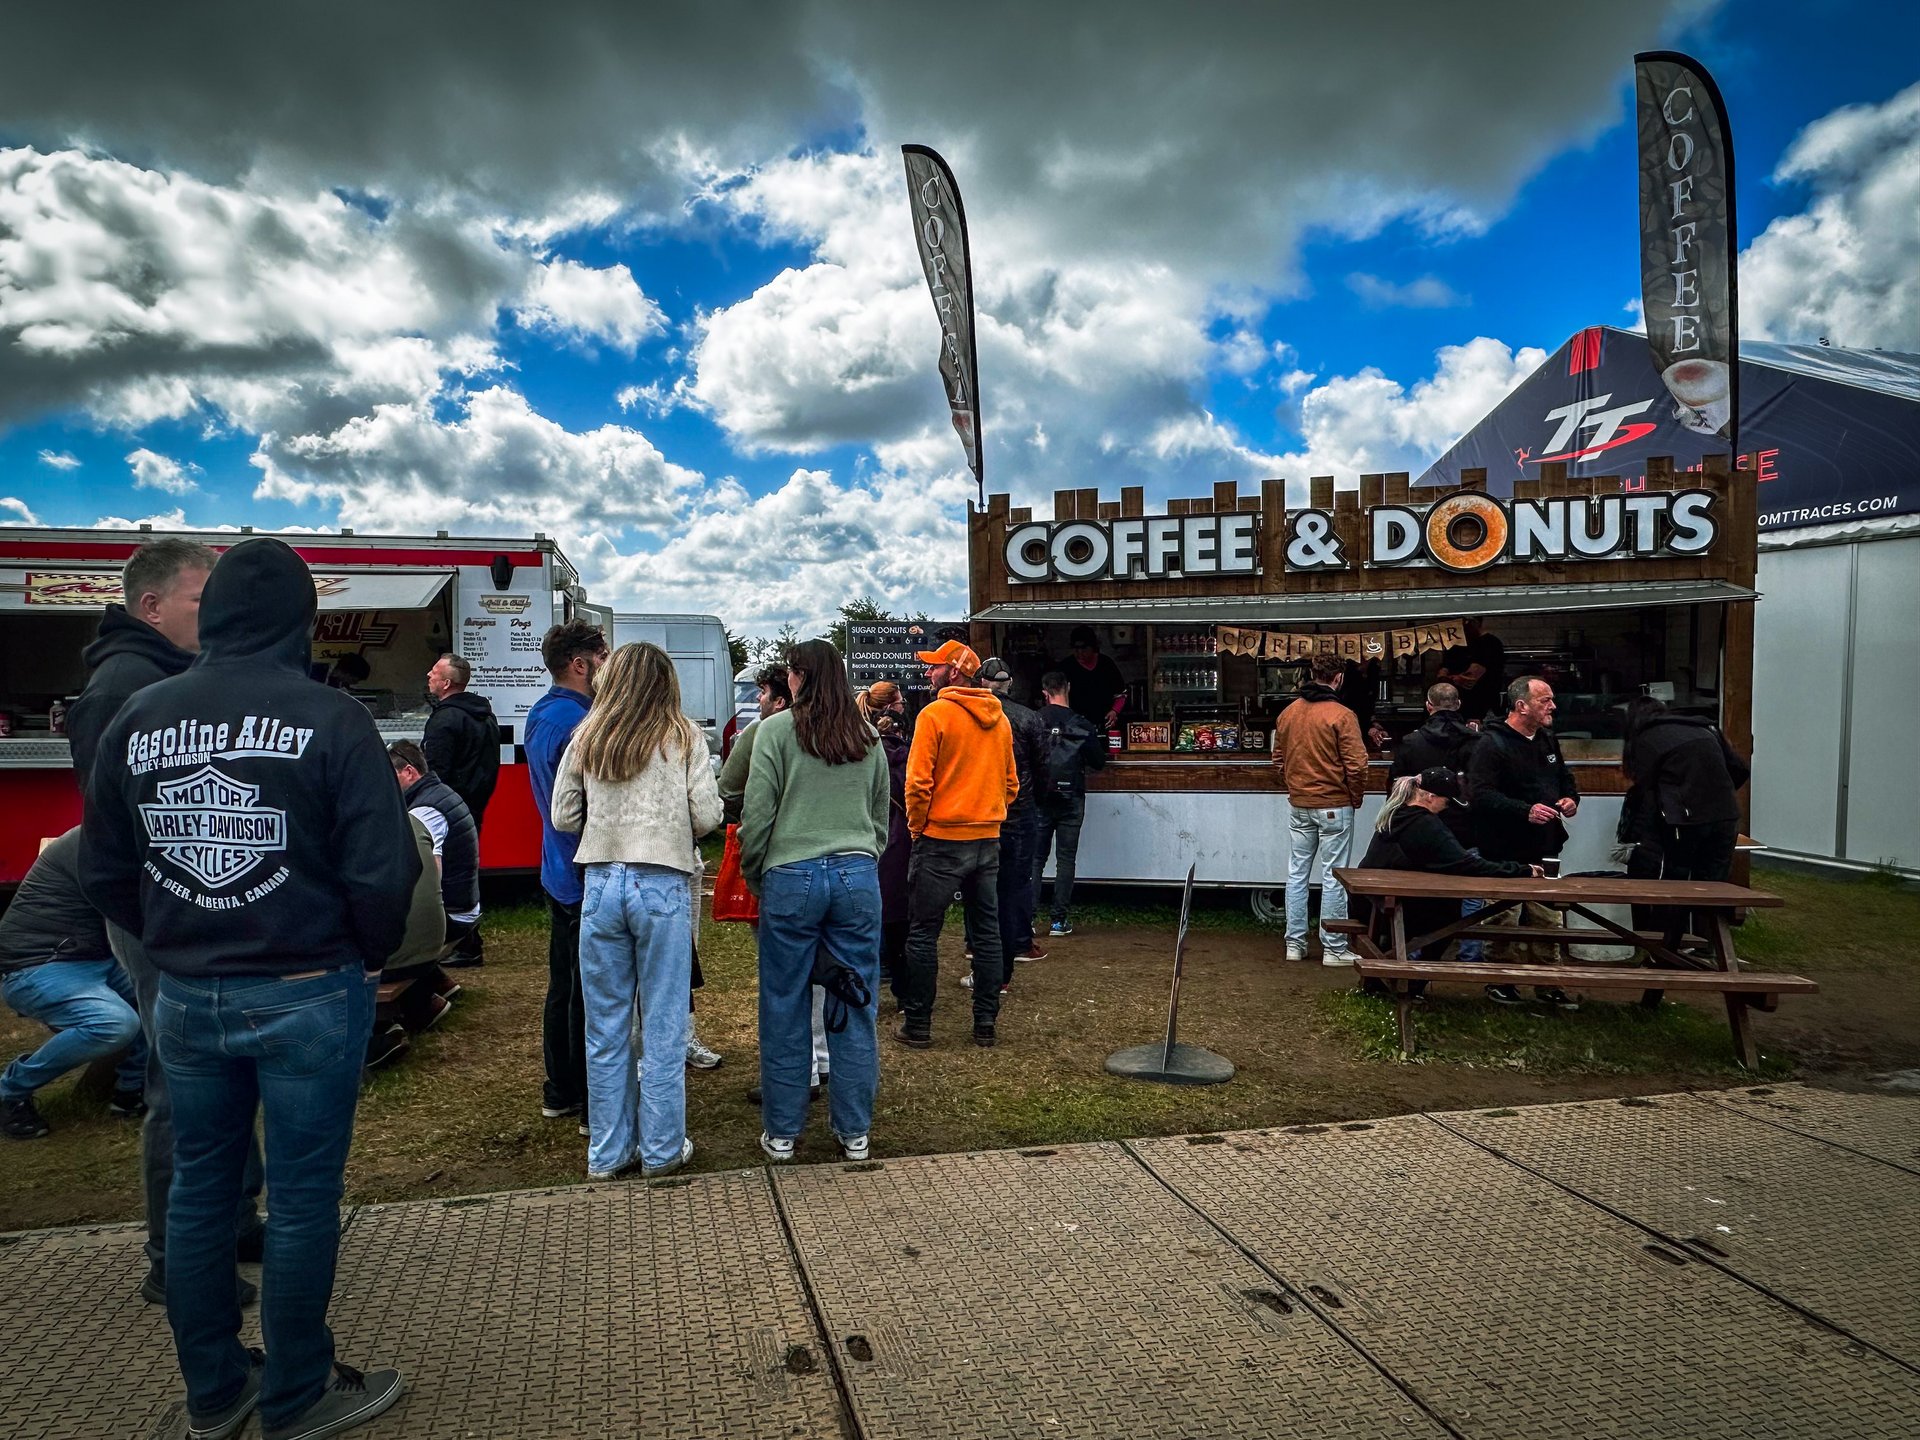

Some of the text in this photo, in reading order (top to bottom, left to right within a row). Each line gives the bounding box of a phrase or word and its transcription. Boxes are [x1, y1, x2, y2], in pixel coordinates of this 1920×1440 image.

[1663, 87, 1701, 354] COFFEE
[1542, 393, 1656, 462] TT
[1006, 491, 1716, 581] COFFEE & DONUTS
[313, 613, 361, 642] hill
[510, 618, 532, 630] Dogs
[851, 626, 907, 634] SUGAR DONUTS
[851, 652, 912, 660] LOADED DONUTS
[1222, 626, 1461, 655] COFFEE BAR
[127, 715, 314, 766] Gasoline Alley
[174, 778, 242, 807] MOTOR
[180, 845, 246, 879] CYCLES
[246, 865, 290, 903] CANADA
